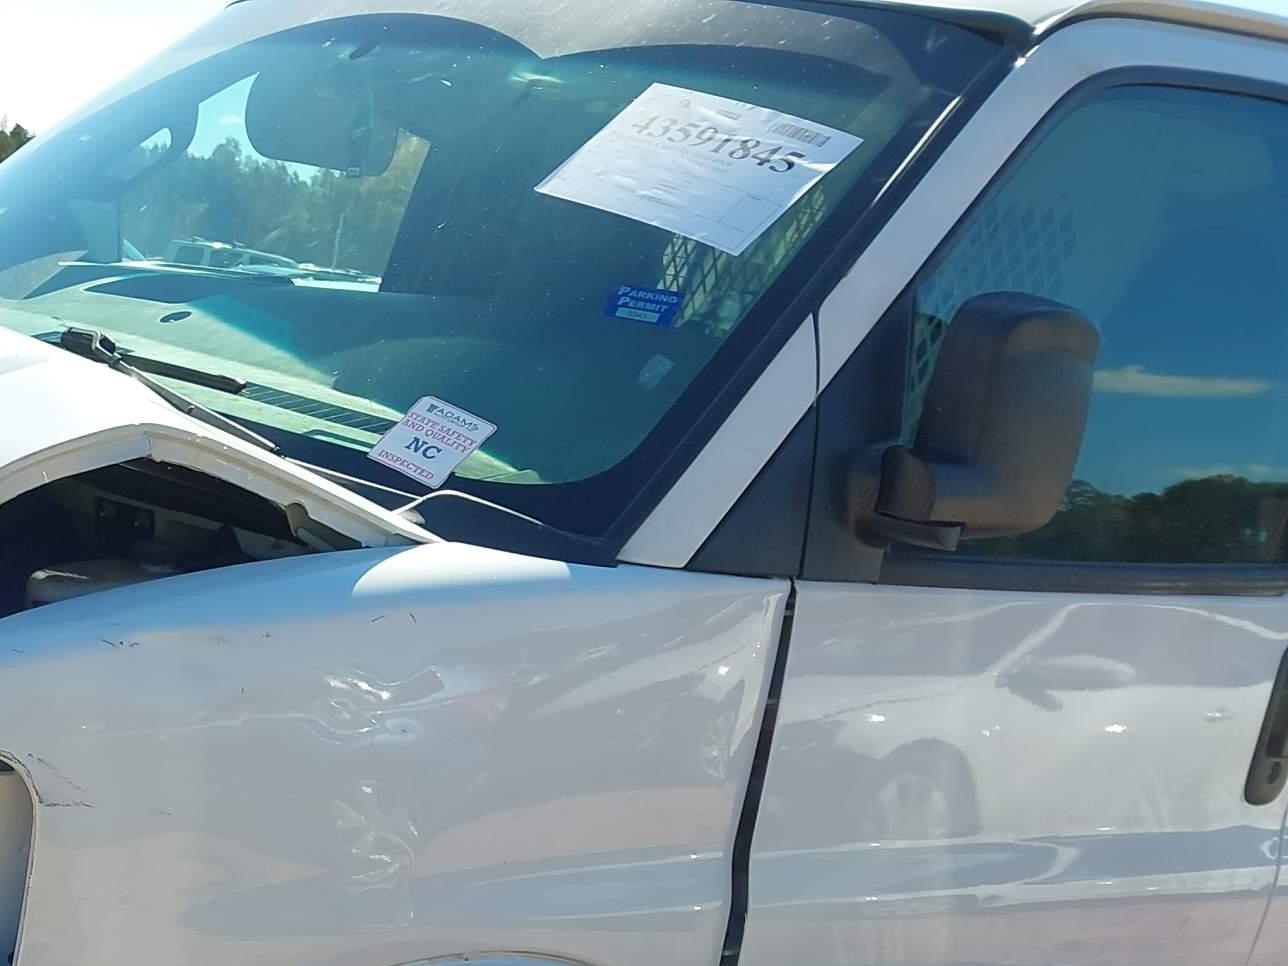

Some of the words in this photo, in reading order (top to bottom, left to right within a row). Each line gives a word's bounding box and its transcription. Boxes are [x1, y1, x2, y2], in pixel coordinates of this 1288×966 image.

[631, 113, 808, 173] 43591845
[407, 411, 440, 429] STATE
[438, 424, 477, 447] SAFETY
[436, 407, 480, 432] ADAMS
[403, 419, 425, 432] AND
[424, 428, 472, 454] QUALITY
[405, 436, 443, 460] NC
[378, 449, 434, 479] INSPECTED
